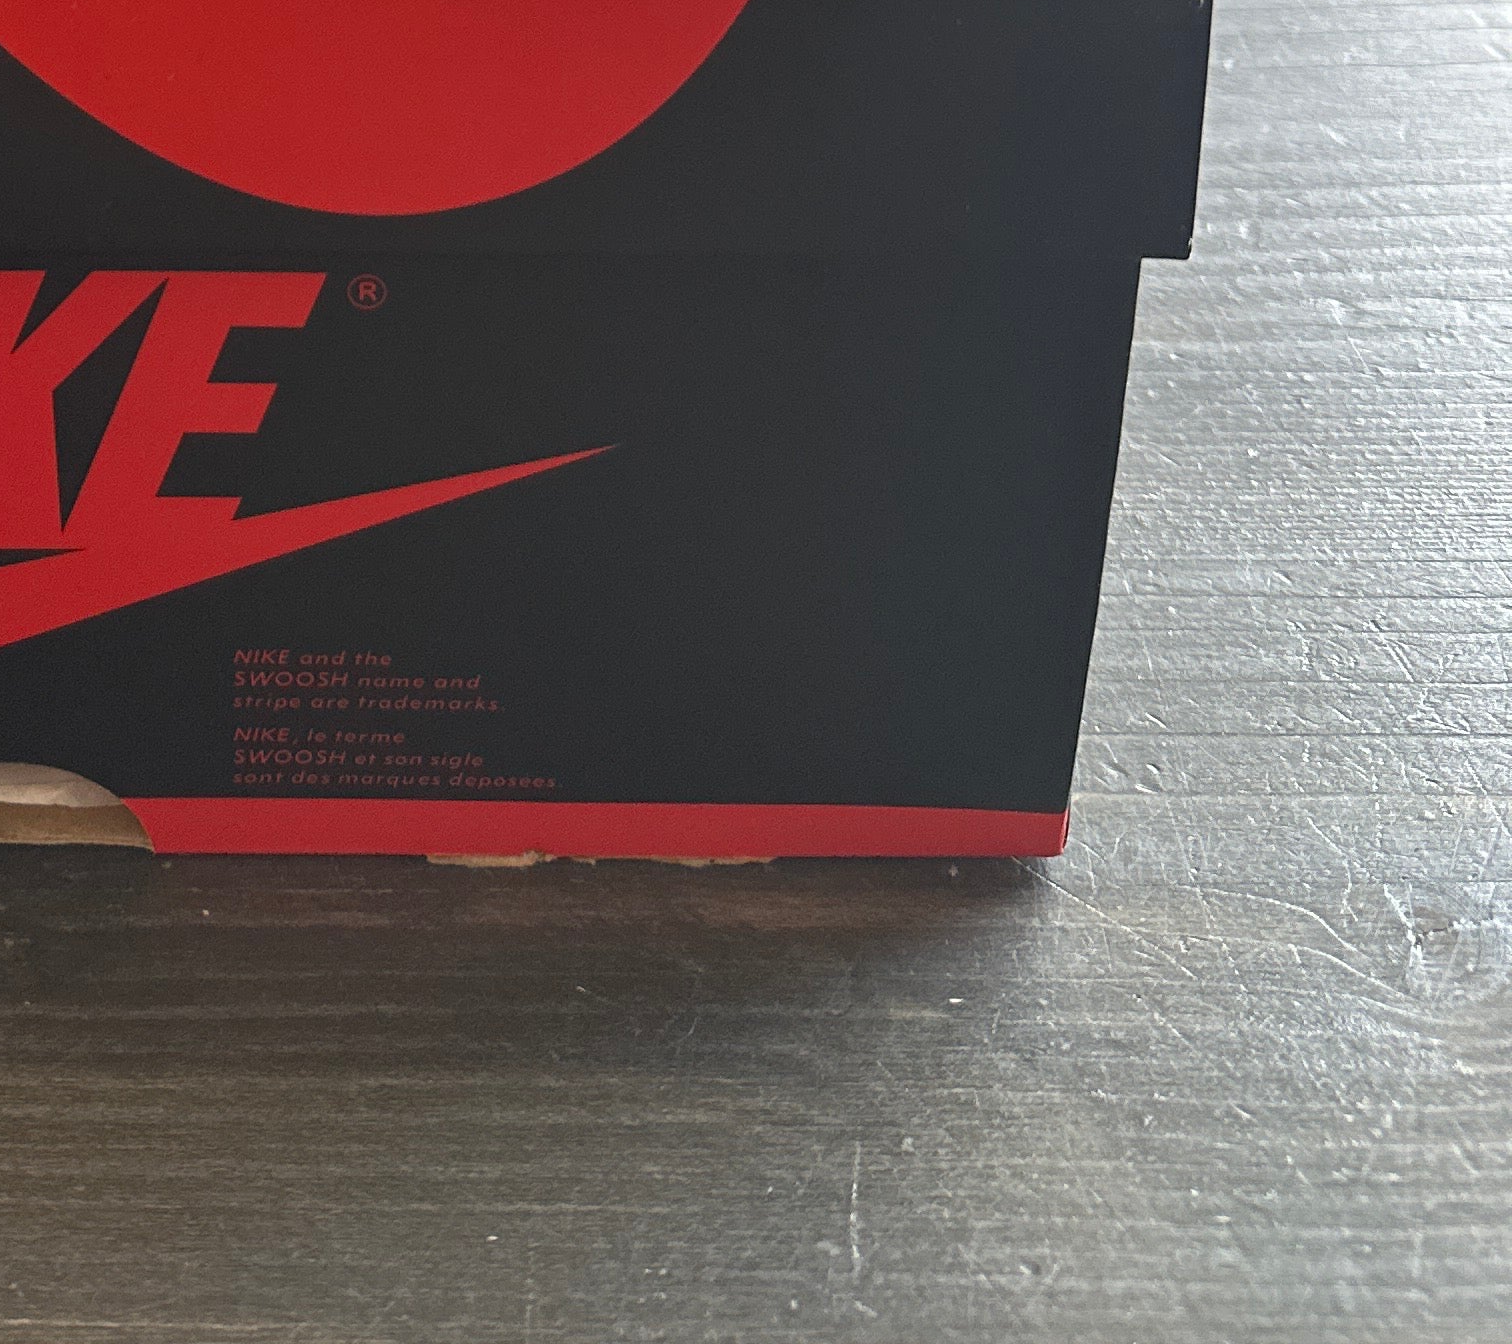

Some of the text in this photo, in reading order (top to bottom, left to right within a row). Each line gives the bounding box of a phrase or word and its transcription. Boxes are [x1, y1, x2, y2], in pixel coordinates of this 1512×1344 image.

[233, 649, 392, 666] NIKE and the
[234, 671, 481, 688] SWOOSH name and
[233, 696, 301, 711] stripe
[311, 698, 349, 709] are
[233, 727, 405, 745] NIKE, le terme
[234, 749, 483, 769] SWOOSH et son sigle
[233, 771, 284, 784] sont
[291, 771, 330, 785] des
[339, 774, 441, 788] marques
